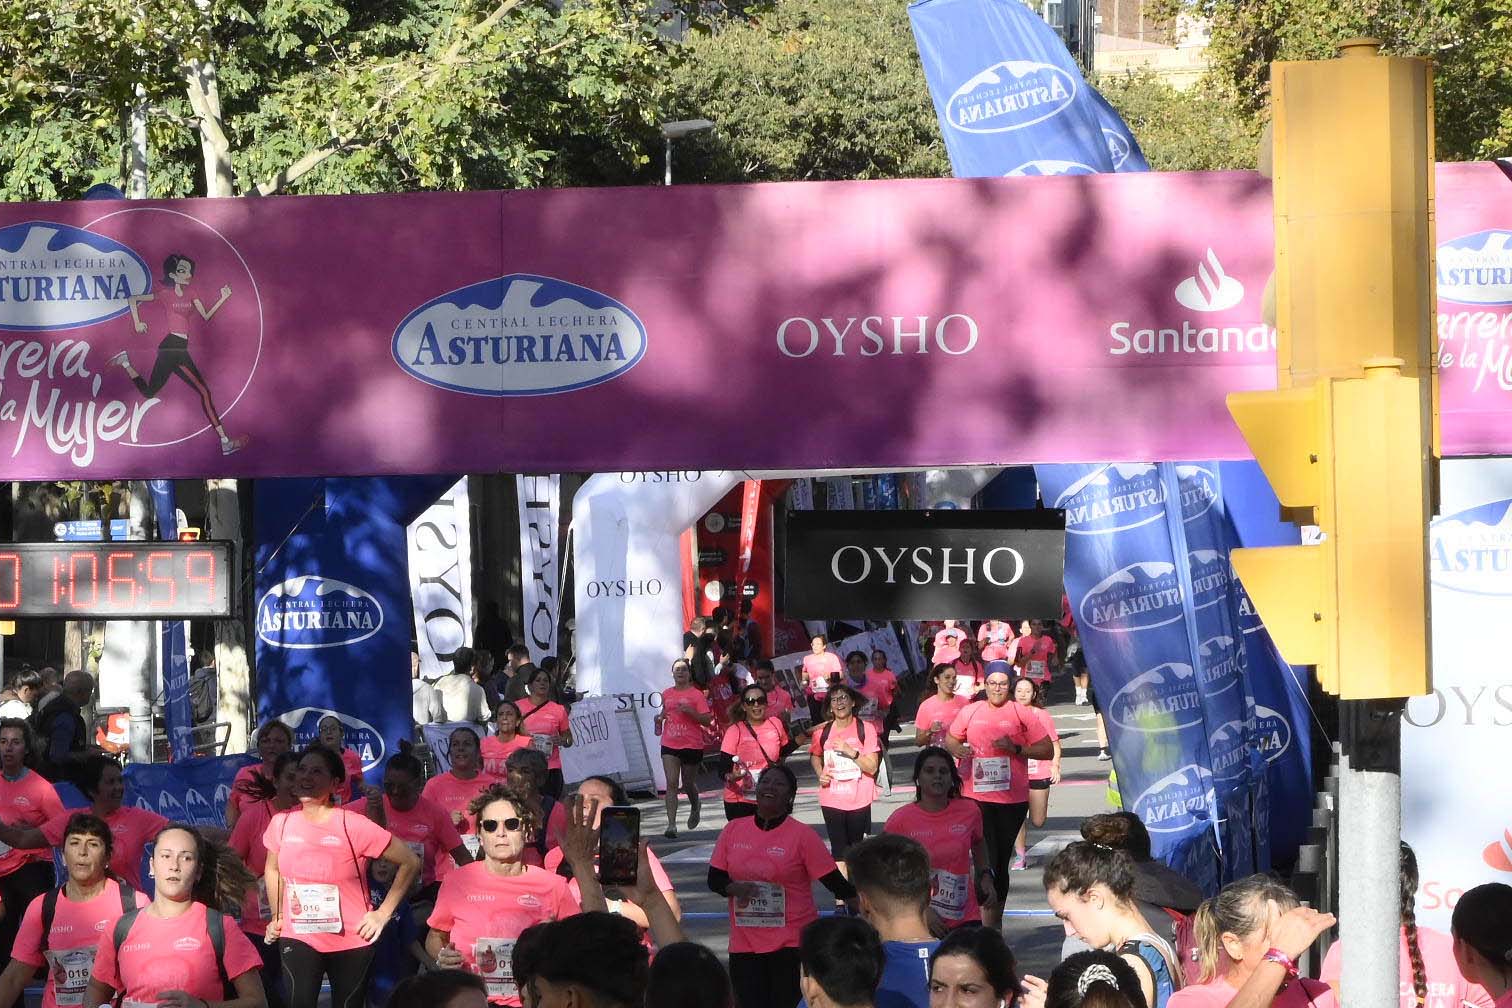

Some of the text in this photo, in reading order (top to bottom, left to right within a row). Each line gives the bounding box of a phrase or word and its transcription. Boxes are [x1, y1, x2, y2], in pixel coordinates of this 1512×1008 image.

[54, 258, 126, 269] LECHERA
[451, 315, 618, 330] CENTRAL LECHERA
[412, 322, 627, 366] ASTURIANA
[776, 313, 979, 357] OYSHO
[12, 374, 161, 467] Mujer
[831, 546, 1024, 586] OYSHO
[587, 579, 662, 598] OYSHO
[260, 606, 374, 633] ASTURIANA
[616, 691, 663, 710] SHO
[68, 968, 89, 979] 016
